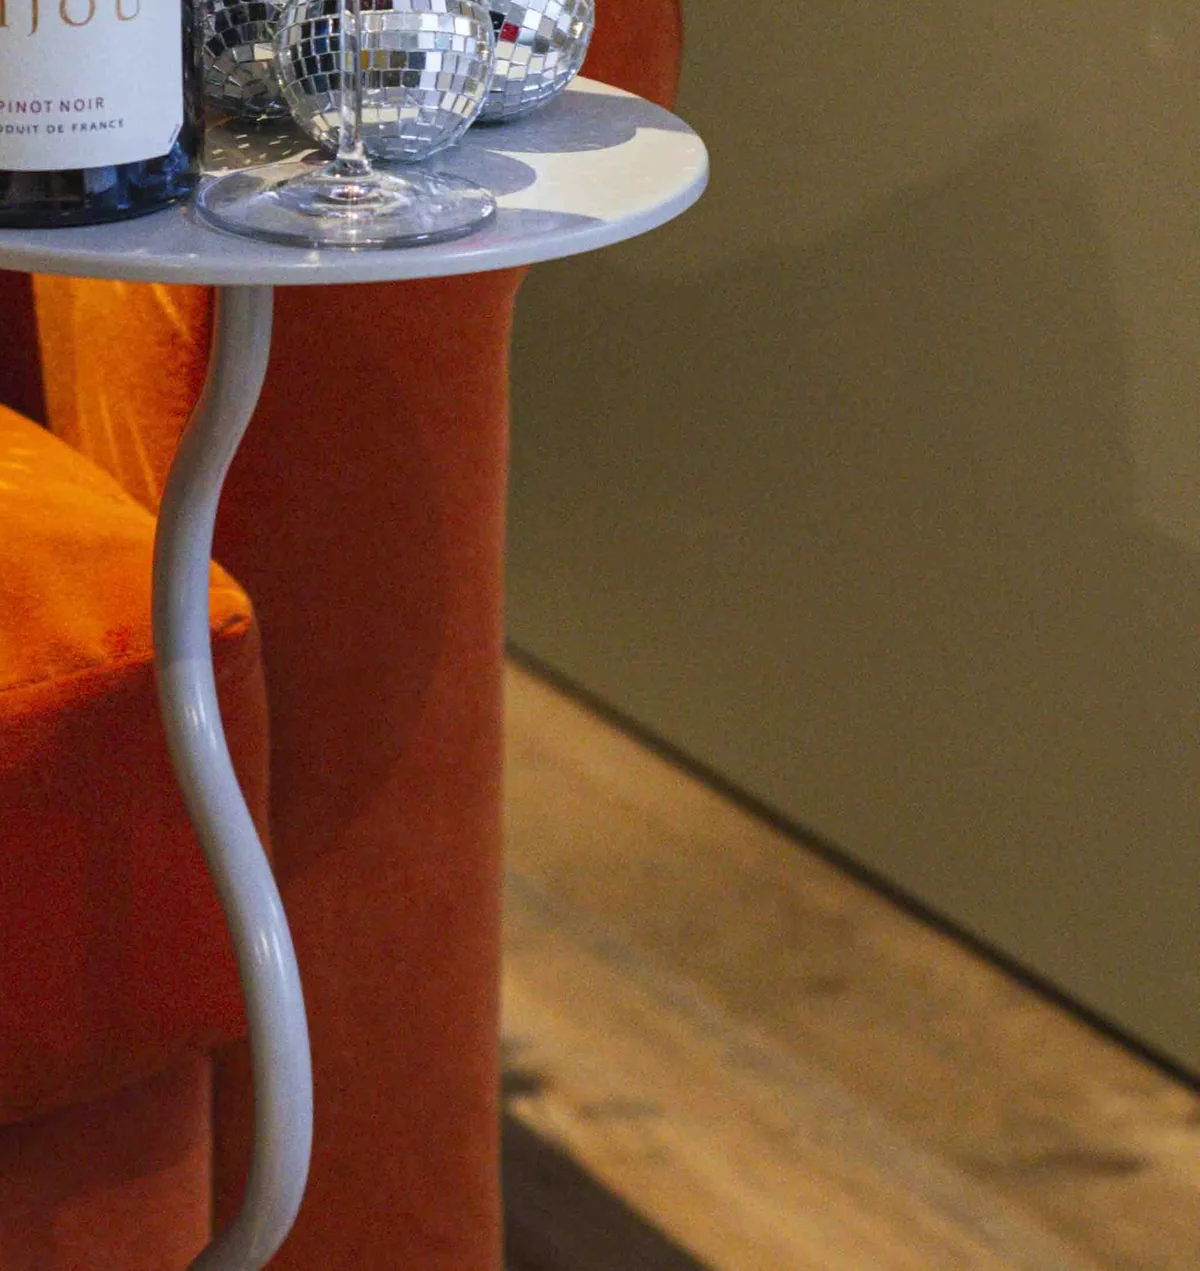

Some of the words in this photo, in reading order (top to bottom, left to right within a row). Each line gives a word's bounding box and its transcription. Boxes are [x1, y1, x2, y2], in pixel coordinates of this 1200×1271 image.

[59, 97, 105, 112] NOIR
[46, 123, 65, 133] DE
[72, 118, 124, 132] FRANCE
